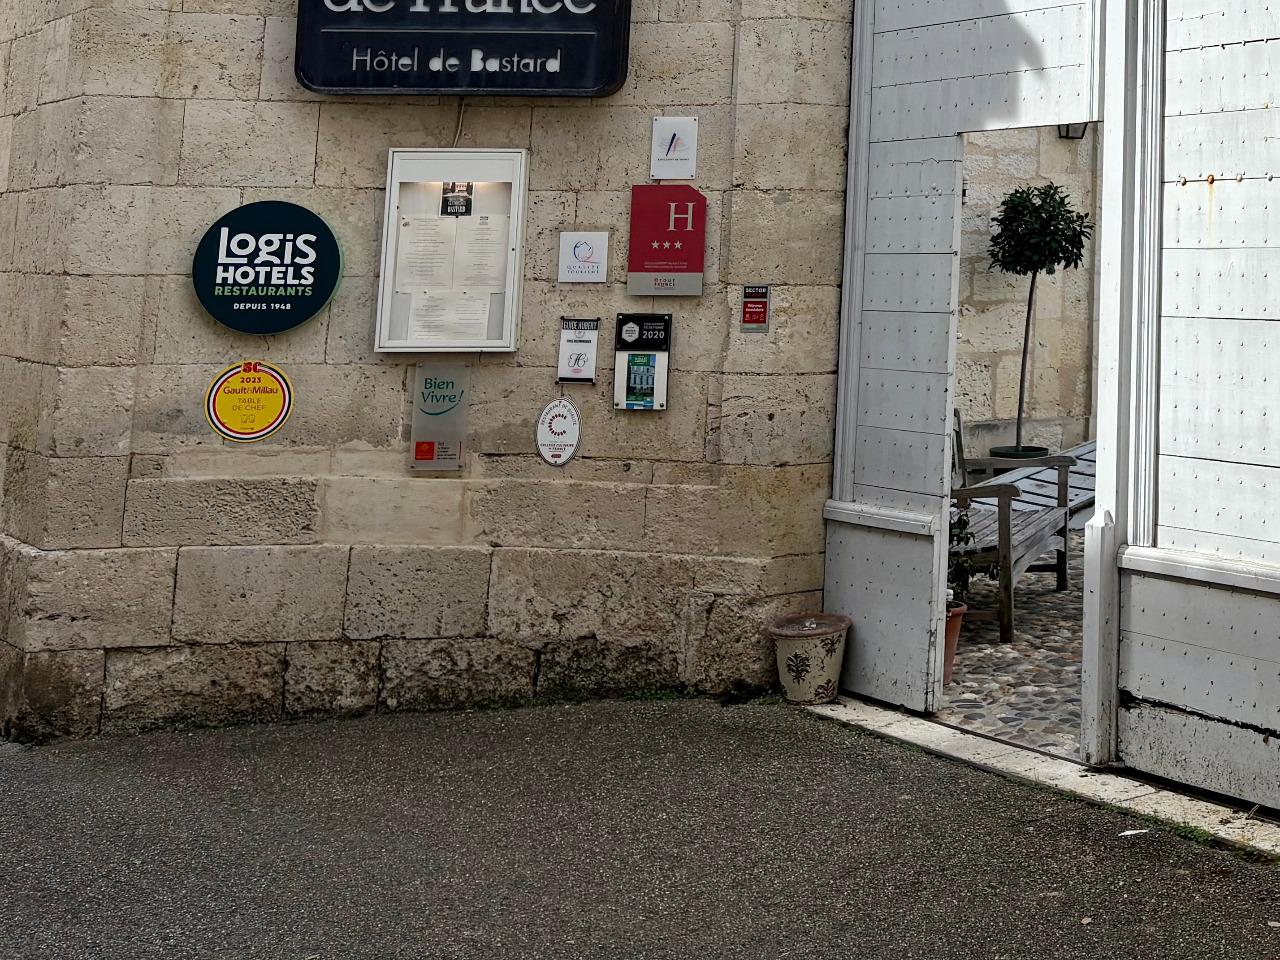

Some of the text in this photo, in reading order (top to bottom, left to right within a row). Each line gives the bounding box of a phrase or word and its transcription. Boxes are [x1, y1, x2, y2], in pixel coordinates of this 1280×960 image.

[352, 47, 561, 73] Hôtel de Bastard
[667, 202, 696, 231] H
[216, 265, 315, 285] HOTELS
[215, 286, 313, 296] RESTAURANTS
[233, 302, 267, 310] DEPUIS
[642, 331, 665, 339] 2020
[240, 376, 262, 384] 2023
[424, 377, 455, 390] Bien
[421, 390, 464, 403] Vivre!
